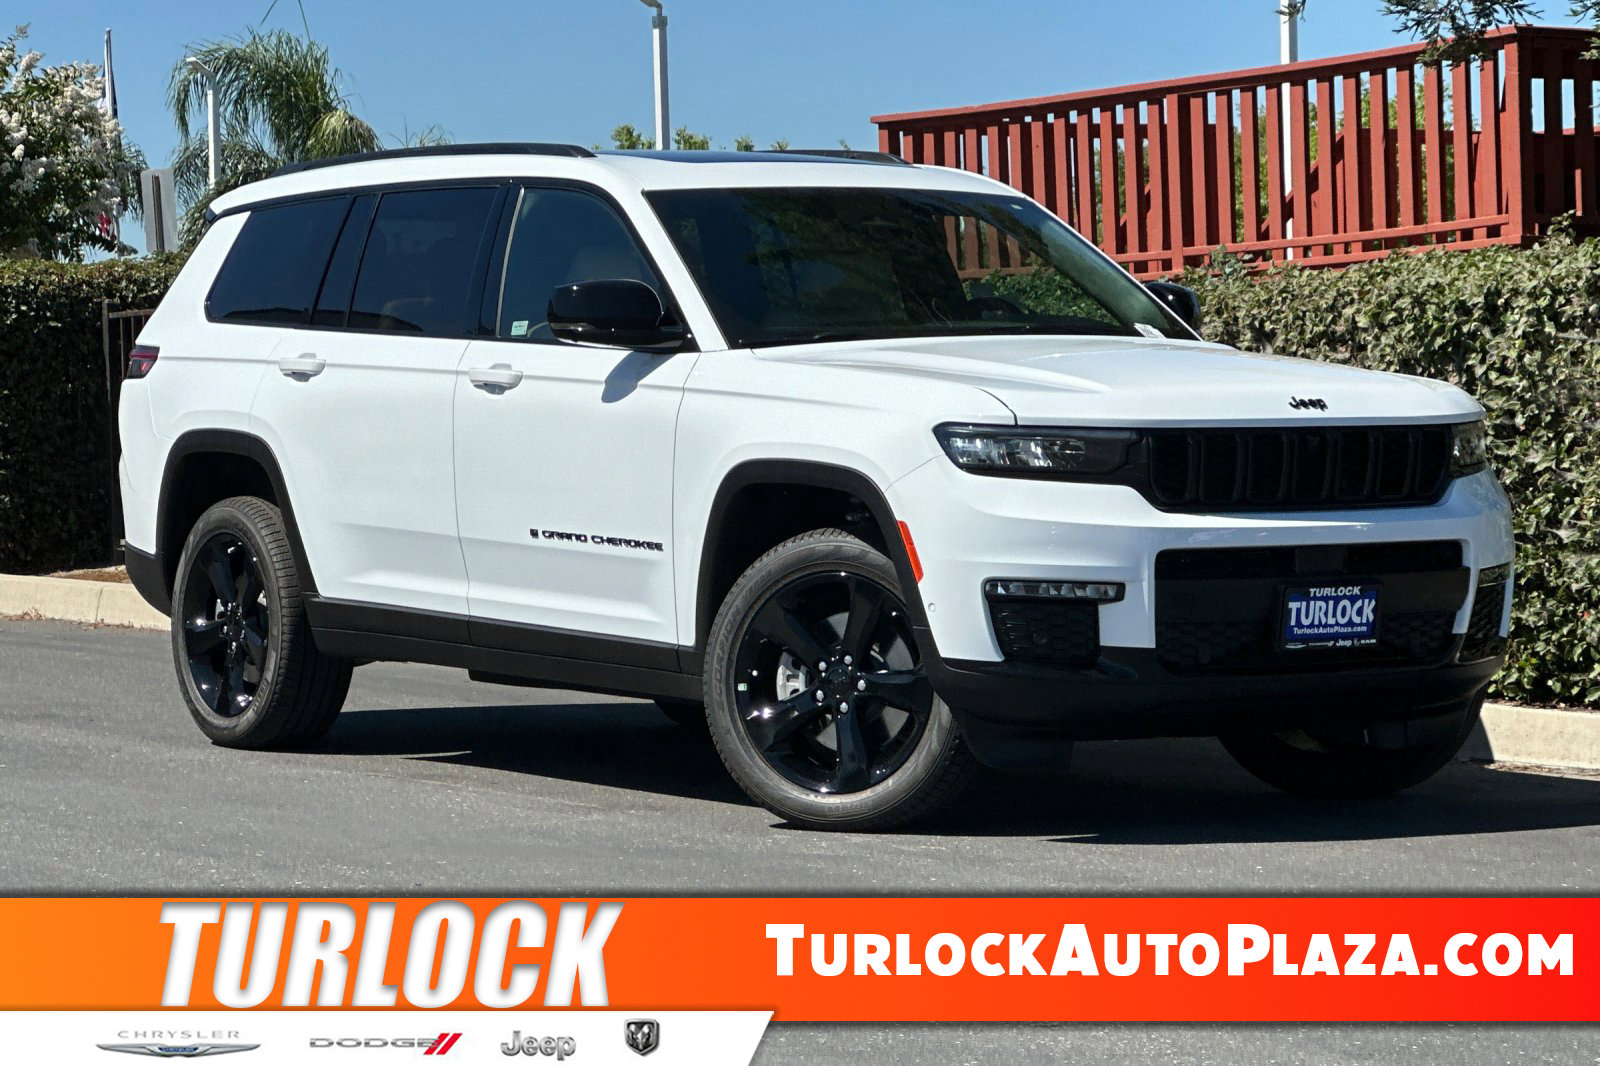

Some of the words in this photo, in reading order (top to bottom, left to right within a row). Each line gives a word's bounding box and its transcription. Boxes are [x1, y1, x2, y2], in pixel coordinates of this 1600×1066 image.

[1288, 396, 1328, 412] Jeep
[541, 529, 588, 543] GRAND
[591, 534, 664, 551] CHEROKEE
[1309, 586, 1361, 597] TURLOCK
[1288, 598, 1376, 626] TURLOCK
[1293, 625, 1367, 635] TurlockAutoPlaza.com
